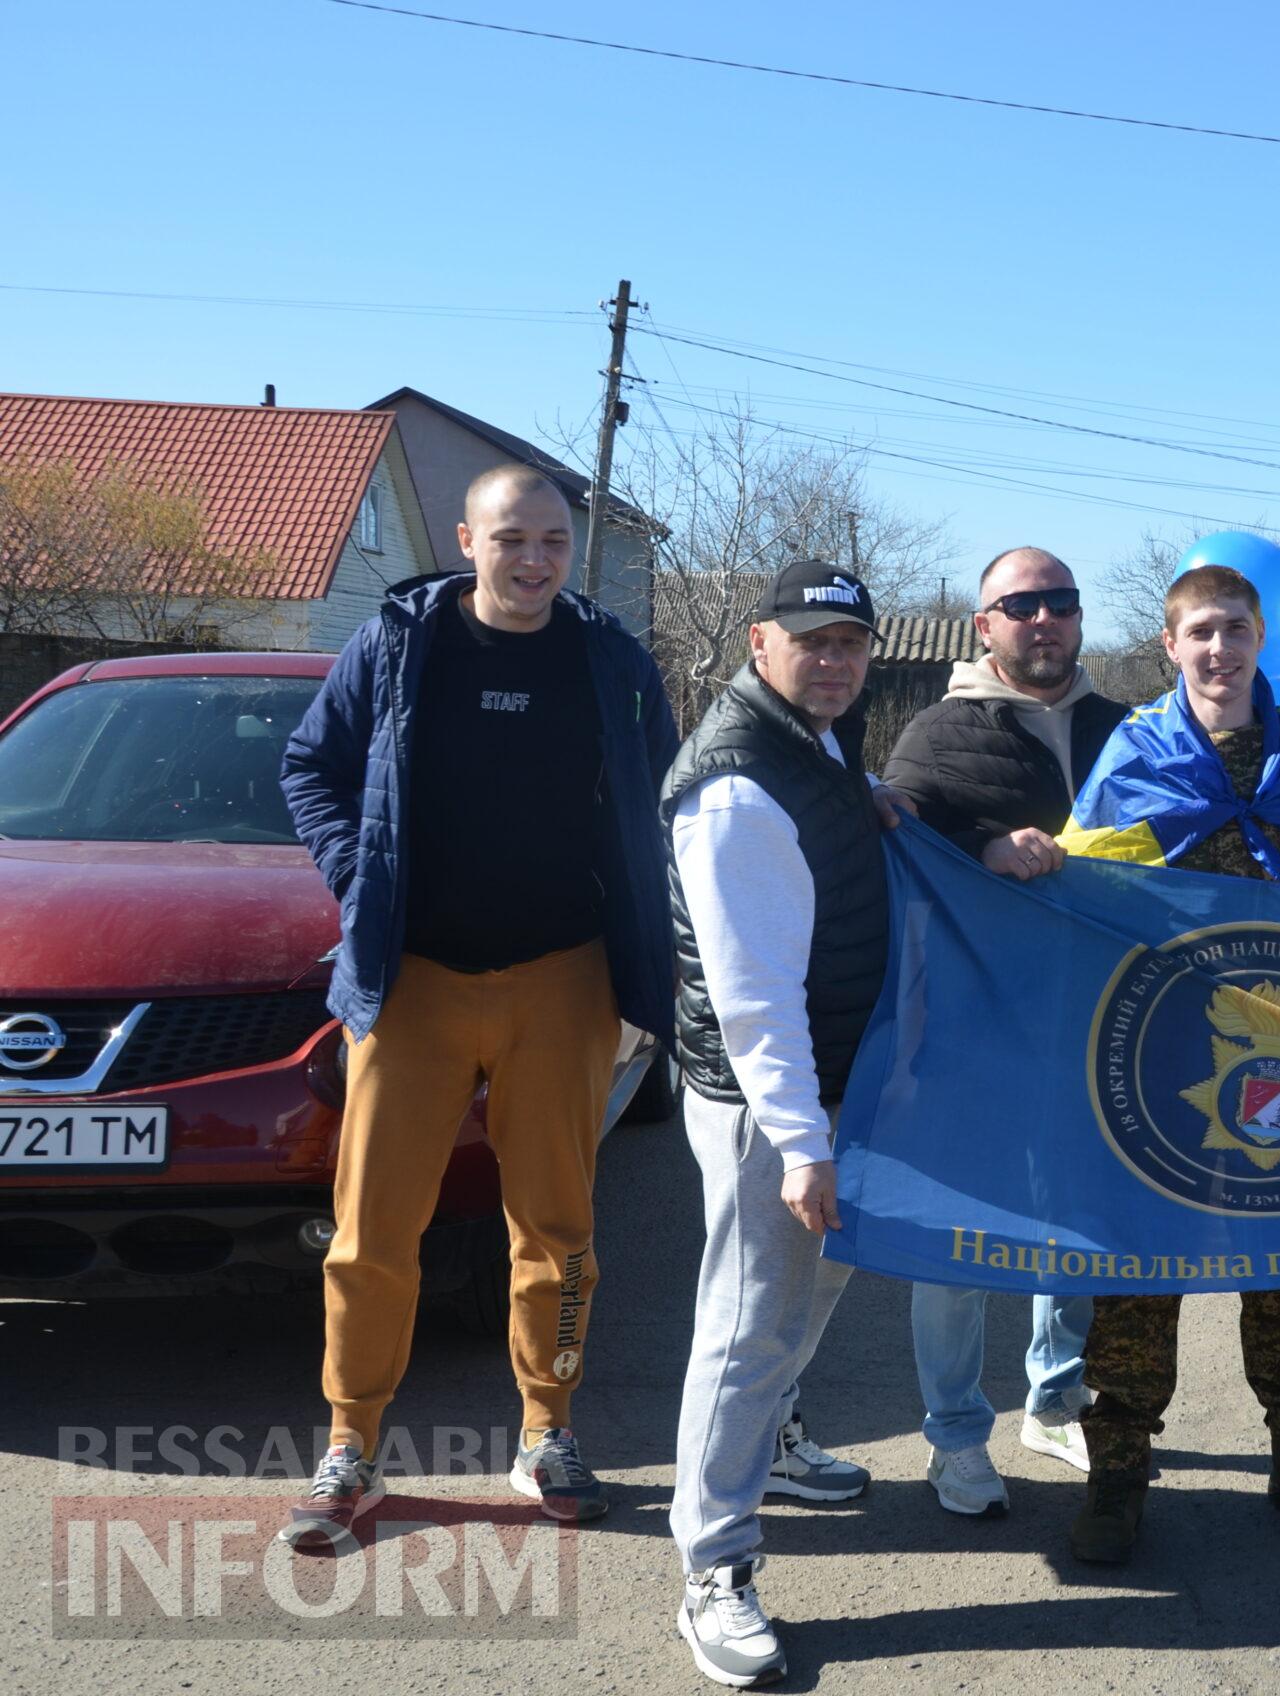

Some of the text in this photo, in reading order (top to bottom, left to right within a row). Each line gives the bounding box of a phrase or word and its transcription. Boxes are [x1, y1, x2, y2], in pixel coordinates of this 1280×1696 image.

[803, 586, 855, 605] PUMA
[481, 690, 530, 712] STAFF
[1108, 999, 1138, 1110] ОКРЕМИЙ
[0, 1116, 157, 1156] 721 TM
[1121, 1113, 1140, 1133] 18
[950, 1226, 1255, 1281] Національна
